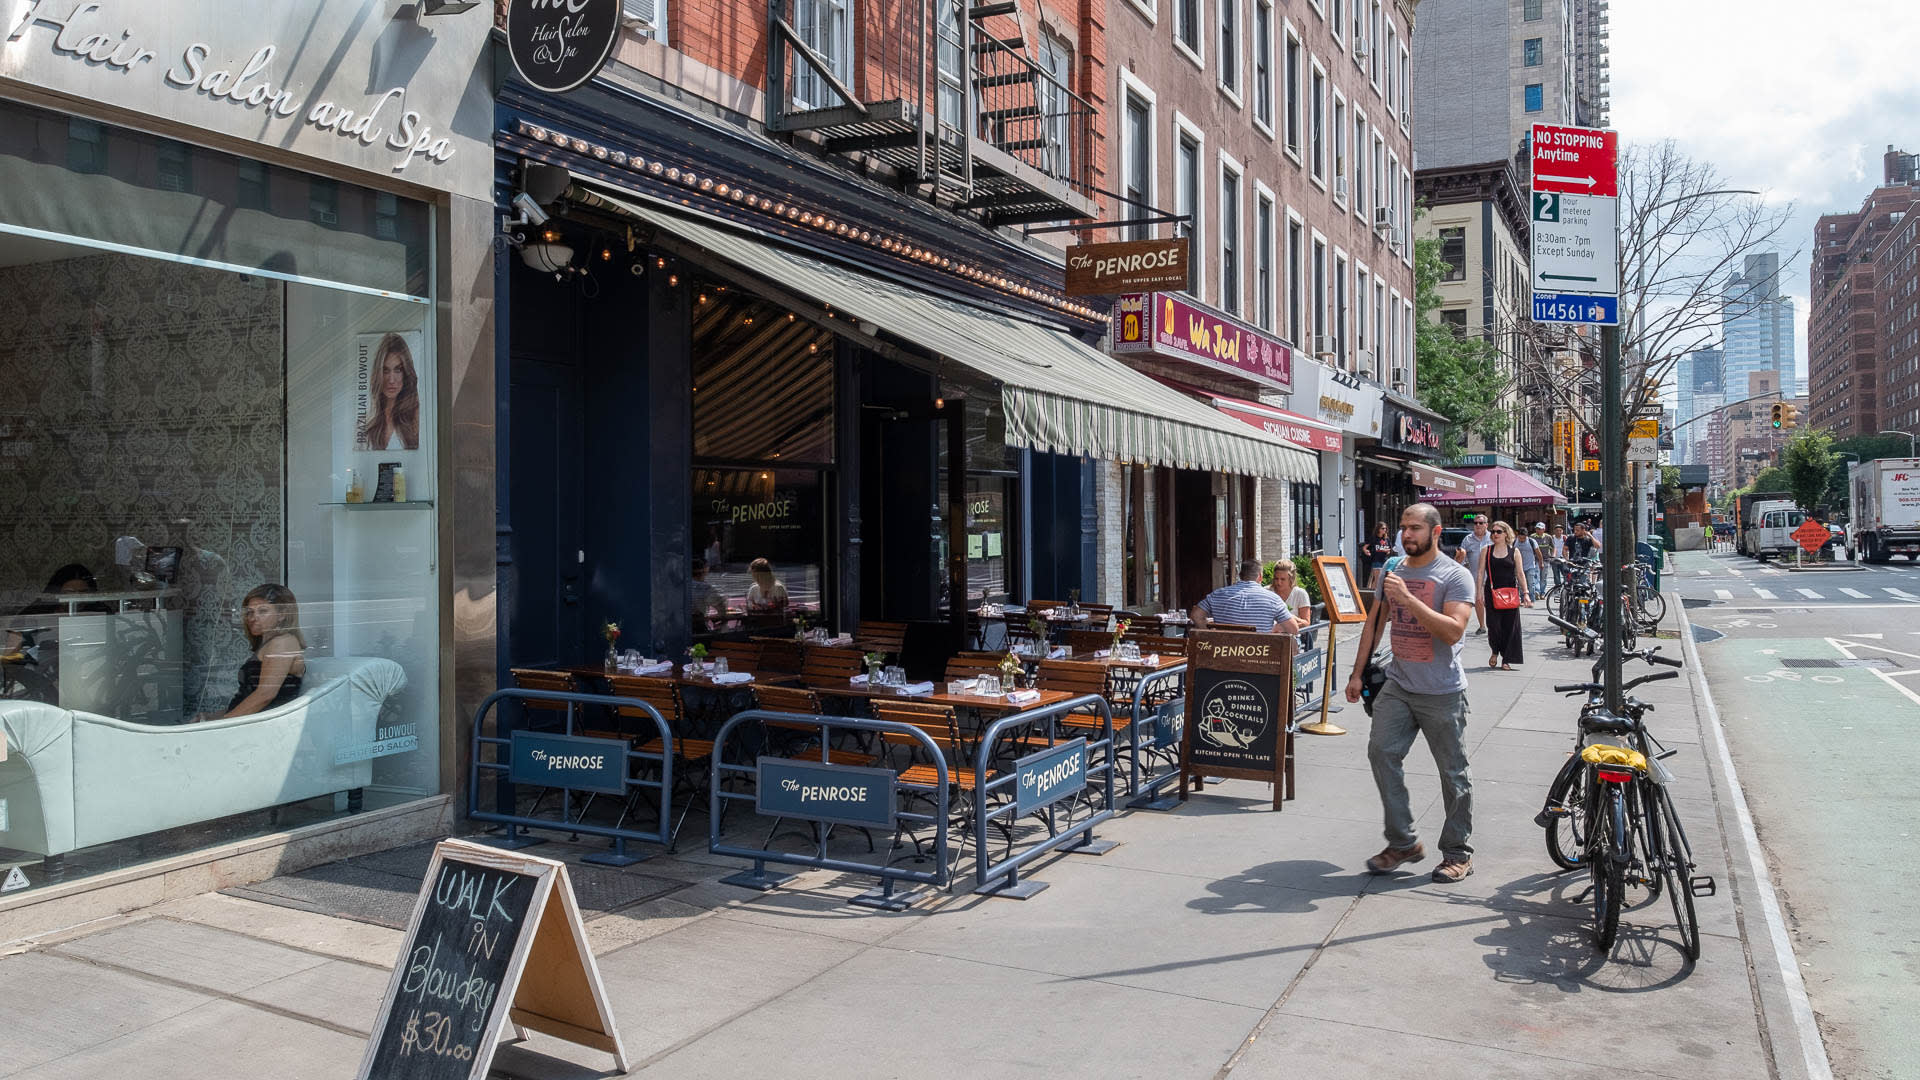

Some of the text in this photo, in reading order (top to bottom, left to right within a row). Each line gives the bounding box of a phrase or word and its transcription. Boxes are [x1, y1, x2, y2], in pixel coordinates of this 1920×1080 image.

[531, 22, 558, 42] Hair
[7, 0, 456, 172] Hair Salon and Spa
[1536, 131, 1604, 149] NO STOPPING
[1537, 146, 1580, 163] Anytime
[1539, 193, 1553, 220] 2
[1562, 197, 1578, 206] hour
[1562, 206, 1591, 216] metered
[1562, 216, 1588, 226] parking
[1537, 232, 1567, 244] 8:30am
[1575, 235, 1591, 246] 7pm
[1537, 244, 1595, 259] Except Sunday
[1070, 248, 1180, 279] The PENROSE
[1535, 302, 1583, 321] 114561
[1189, 313, 1211, 353] Wa
[1213, 324, 1240, 363] Jeal
[356, 343, 369, 444] BRAZILIAN BLOWOUT
[1263, 421, 1290, 441] SICHUAN
[1290, 426, 1312, 444] CUISINE
[1891, 473, 1910, 482] JFC
[731, 500, 792, 525] PENROSE
[1197, 640, 1271, 658] The PENROSE
[1224, 683, 1247, 691] SERVING
[1231, 703, 1262, 712] DINNER
[1224, 710, 1264, 724] COCKTAILS
[378, 722, 417, 740] BLOWOUT
[386, 738, 417, 752] SALON
[1195, 749, 1221, 757] KITCHEN
[1223, 751, 1241, 759] OPEN
[531, 749, 604, 770] The PENROSE
[1022, 752, 1080, 797] The PENROSE
[781, 779, 867, 802] The PENROSE
[436, 865, 519, 923] WALK
[400, 1009, 473, 1061] $30.00
